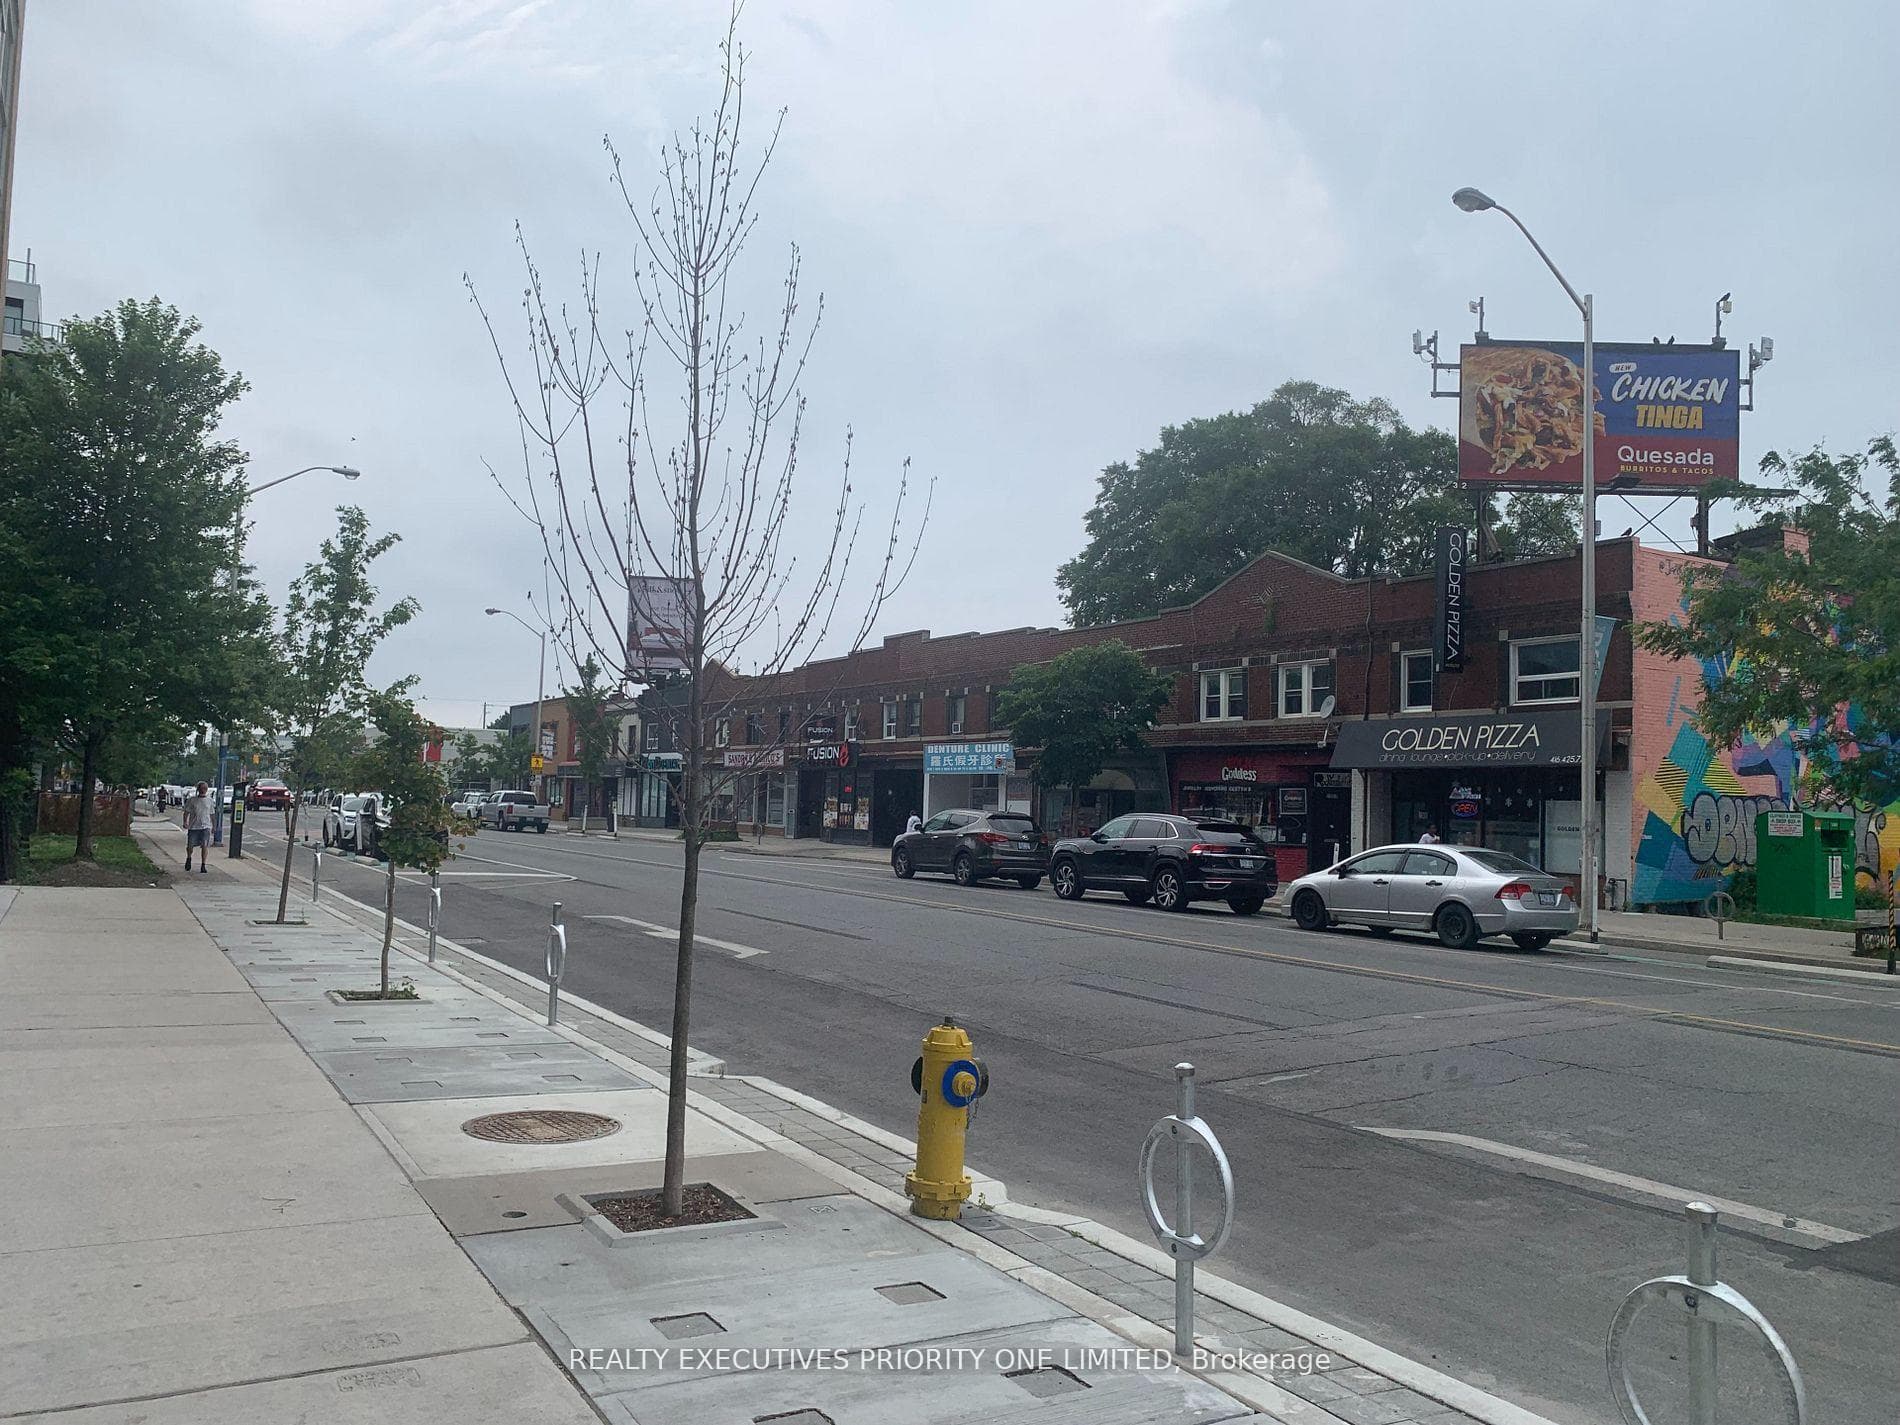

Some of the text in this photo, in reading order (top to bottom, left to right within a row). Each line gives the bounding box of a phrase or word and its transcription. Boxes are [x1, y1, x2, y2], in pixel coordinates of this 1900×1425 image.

[1614, 364, 1632, 372] NEW
[1611, 373, 1729, 404] CHICKEN
[1636, 405, 1703, 429] TINGA
[1617, 445, 1714, 465] Quesada
[1620, 464, 1668, 473] BURRITOS
[1682, 467, 1714, 475] TACOS
[1448, 532, 1462, 607] GOLDEN
[1447, 610, 1461, 660] PIZZA
[807, 726, 834, 734] FUSION
[1382, 723, 1541, 751] GOLDEN PIZZA
[806, 745, 840, 761] FUSION
[927, 743, 1010, 754] DENTURE CLINIC
[1221, 766, 1257, 782] Goddess
